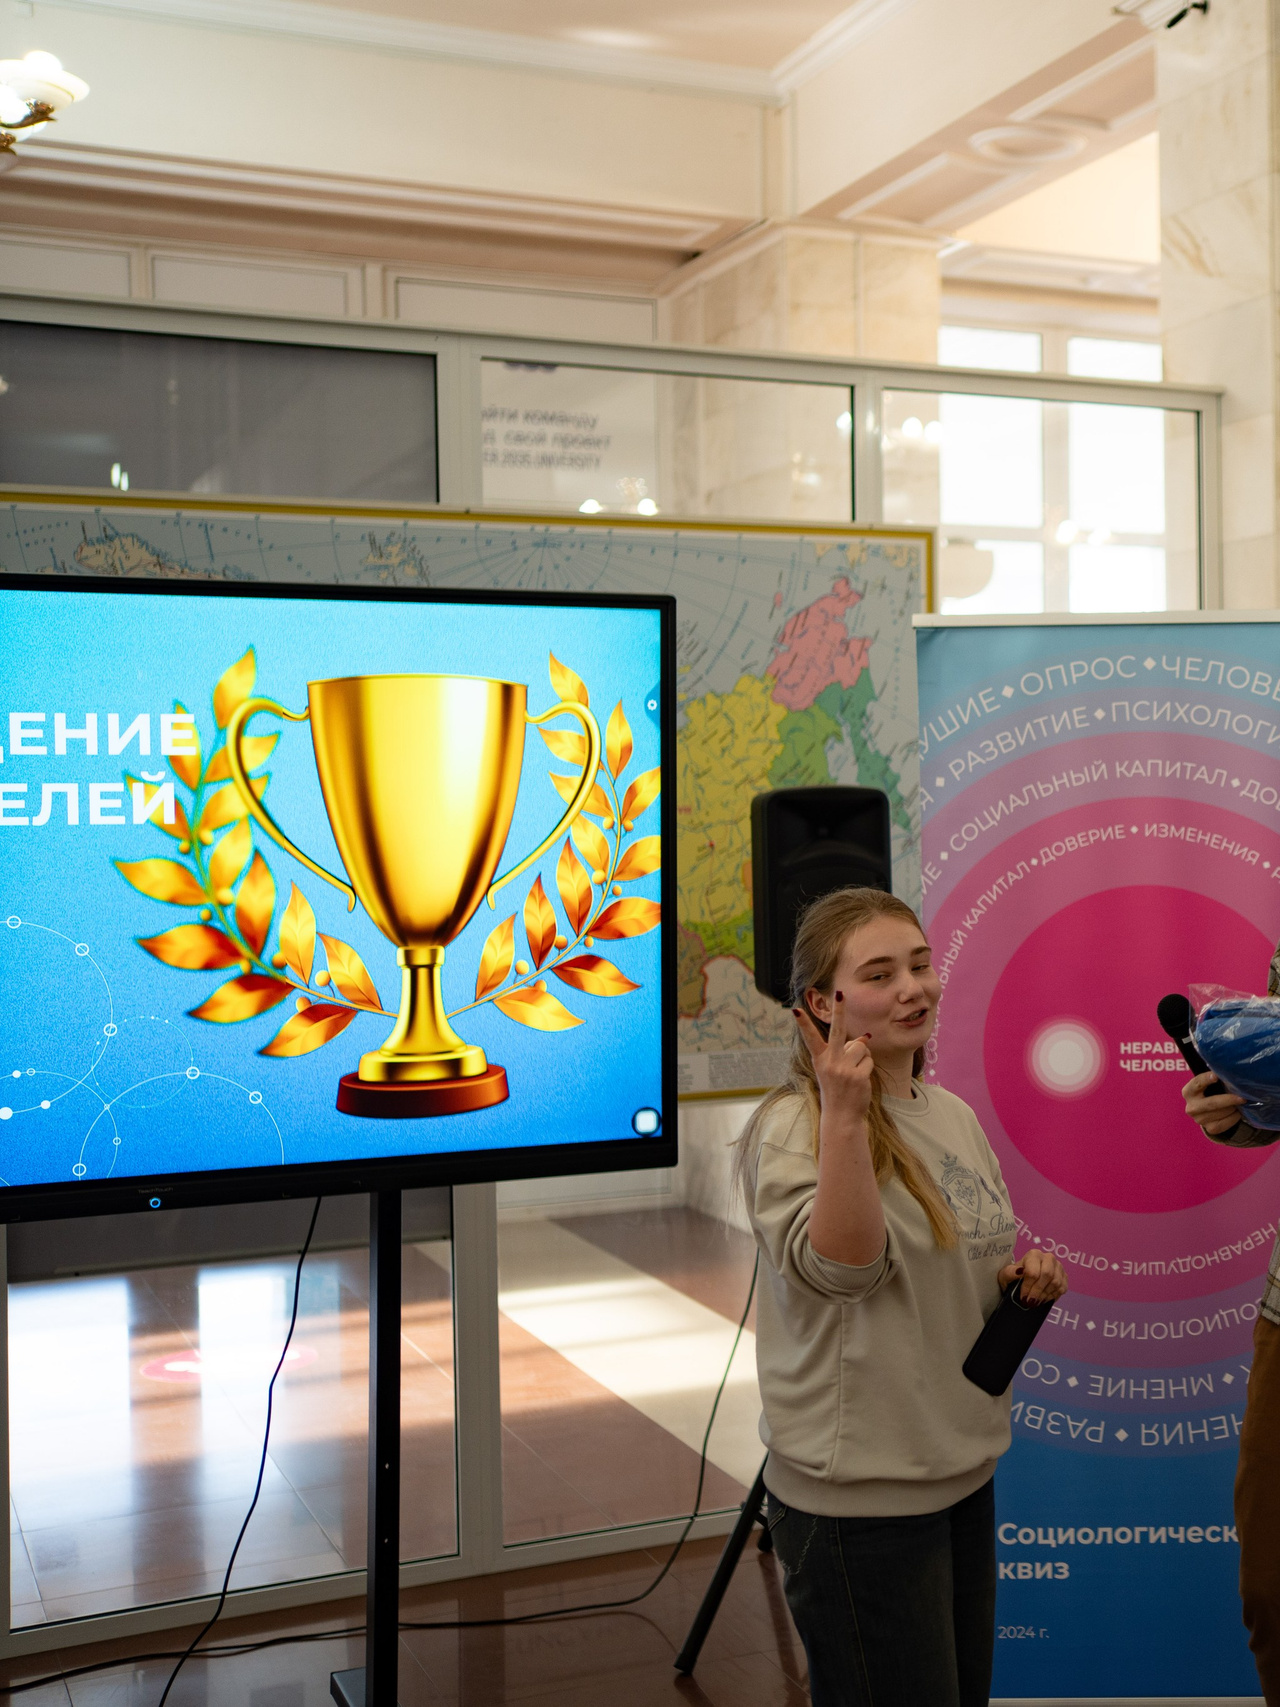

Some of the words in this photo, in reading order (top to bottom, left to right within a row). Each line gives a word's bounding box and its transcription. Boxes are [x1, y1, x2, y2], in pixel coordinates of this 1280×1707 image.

[919, 687, 1001, 761] УШИЕ
[1020, 655, 1137, 696] ОПРОС
[0, 712, 197, 764] ЕНИЕ
[948, 705, 1091, 781] РАЗВИТИЕ
[0, 771, 176, 826] ЕЛЕЙ
[949, 759, 1109, 852] СОЦИАЛЬНЫЙ
[1115, 759, 1228, 788] КАПИТАЛ
[961, 860, 1031, 930] КАПИТАЛ
[1039, 824, 1127, 867] ДОВЕРИЕ
[1144, 823, 1260, 866] ИЗМЕНЕНИЯ
[1119, 1058, 1191, 1072] ЧЕЛОВЕ
[1042, 1238, 1109, 1271] ОПРОС
[1122, 1222, 1278, 1276] НЕРАВНОДУШИЕ
[1103, 1298, 1264, 1340] ОЦИОЛОГИЯ
[1087, 1373, 1215, 1400] МНЕНИЕ
[997, 1522, 1240, 1548] Социологическ
[998, 1561, 1071, 1581] квиз
[997, 1625, 1036, 1640] 2024
